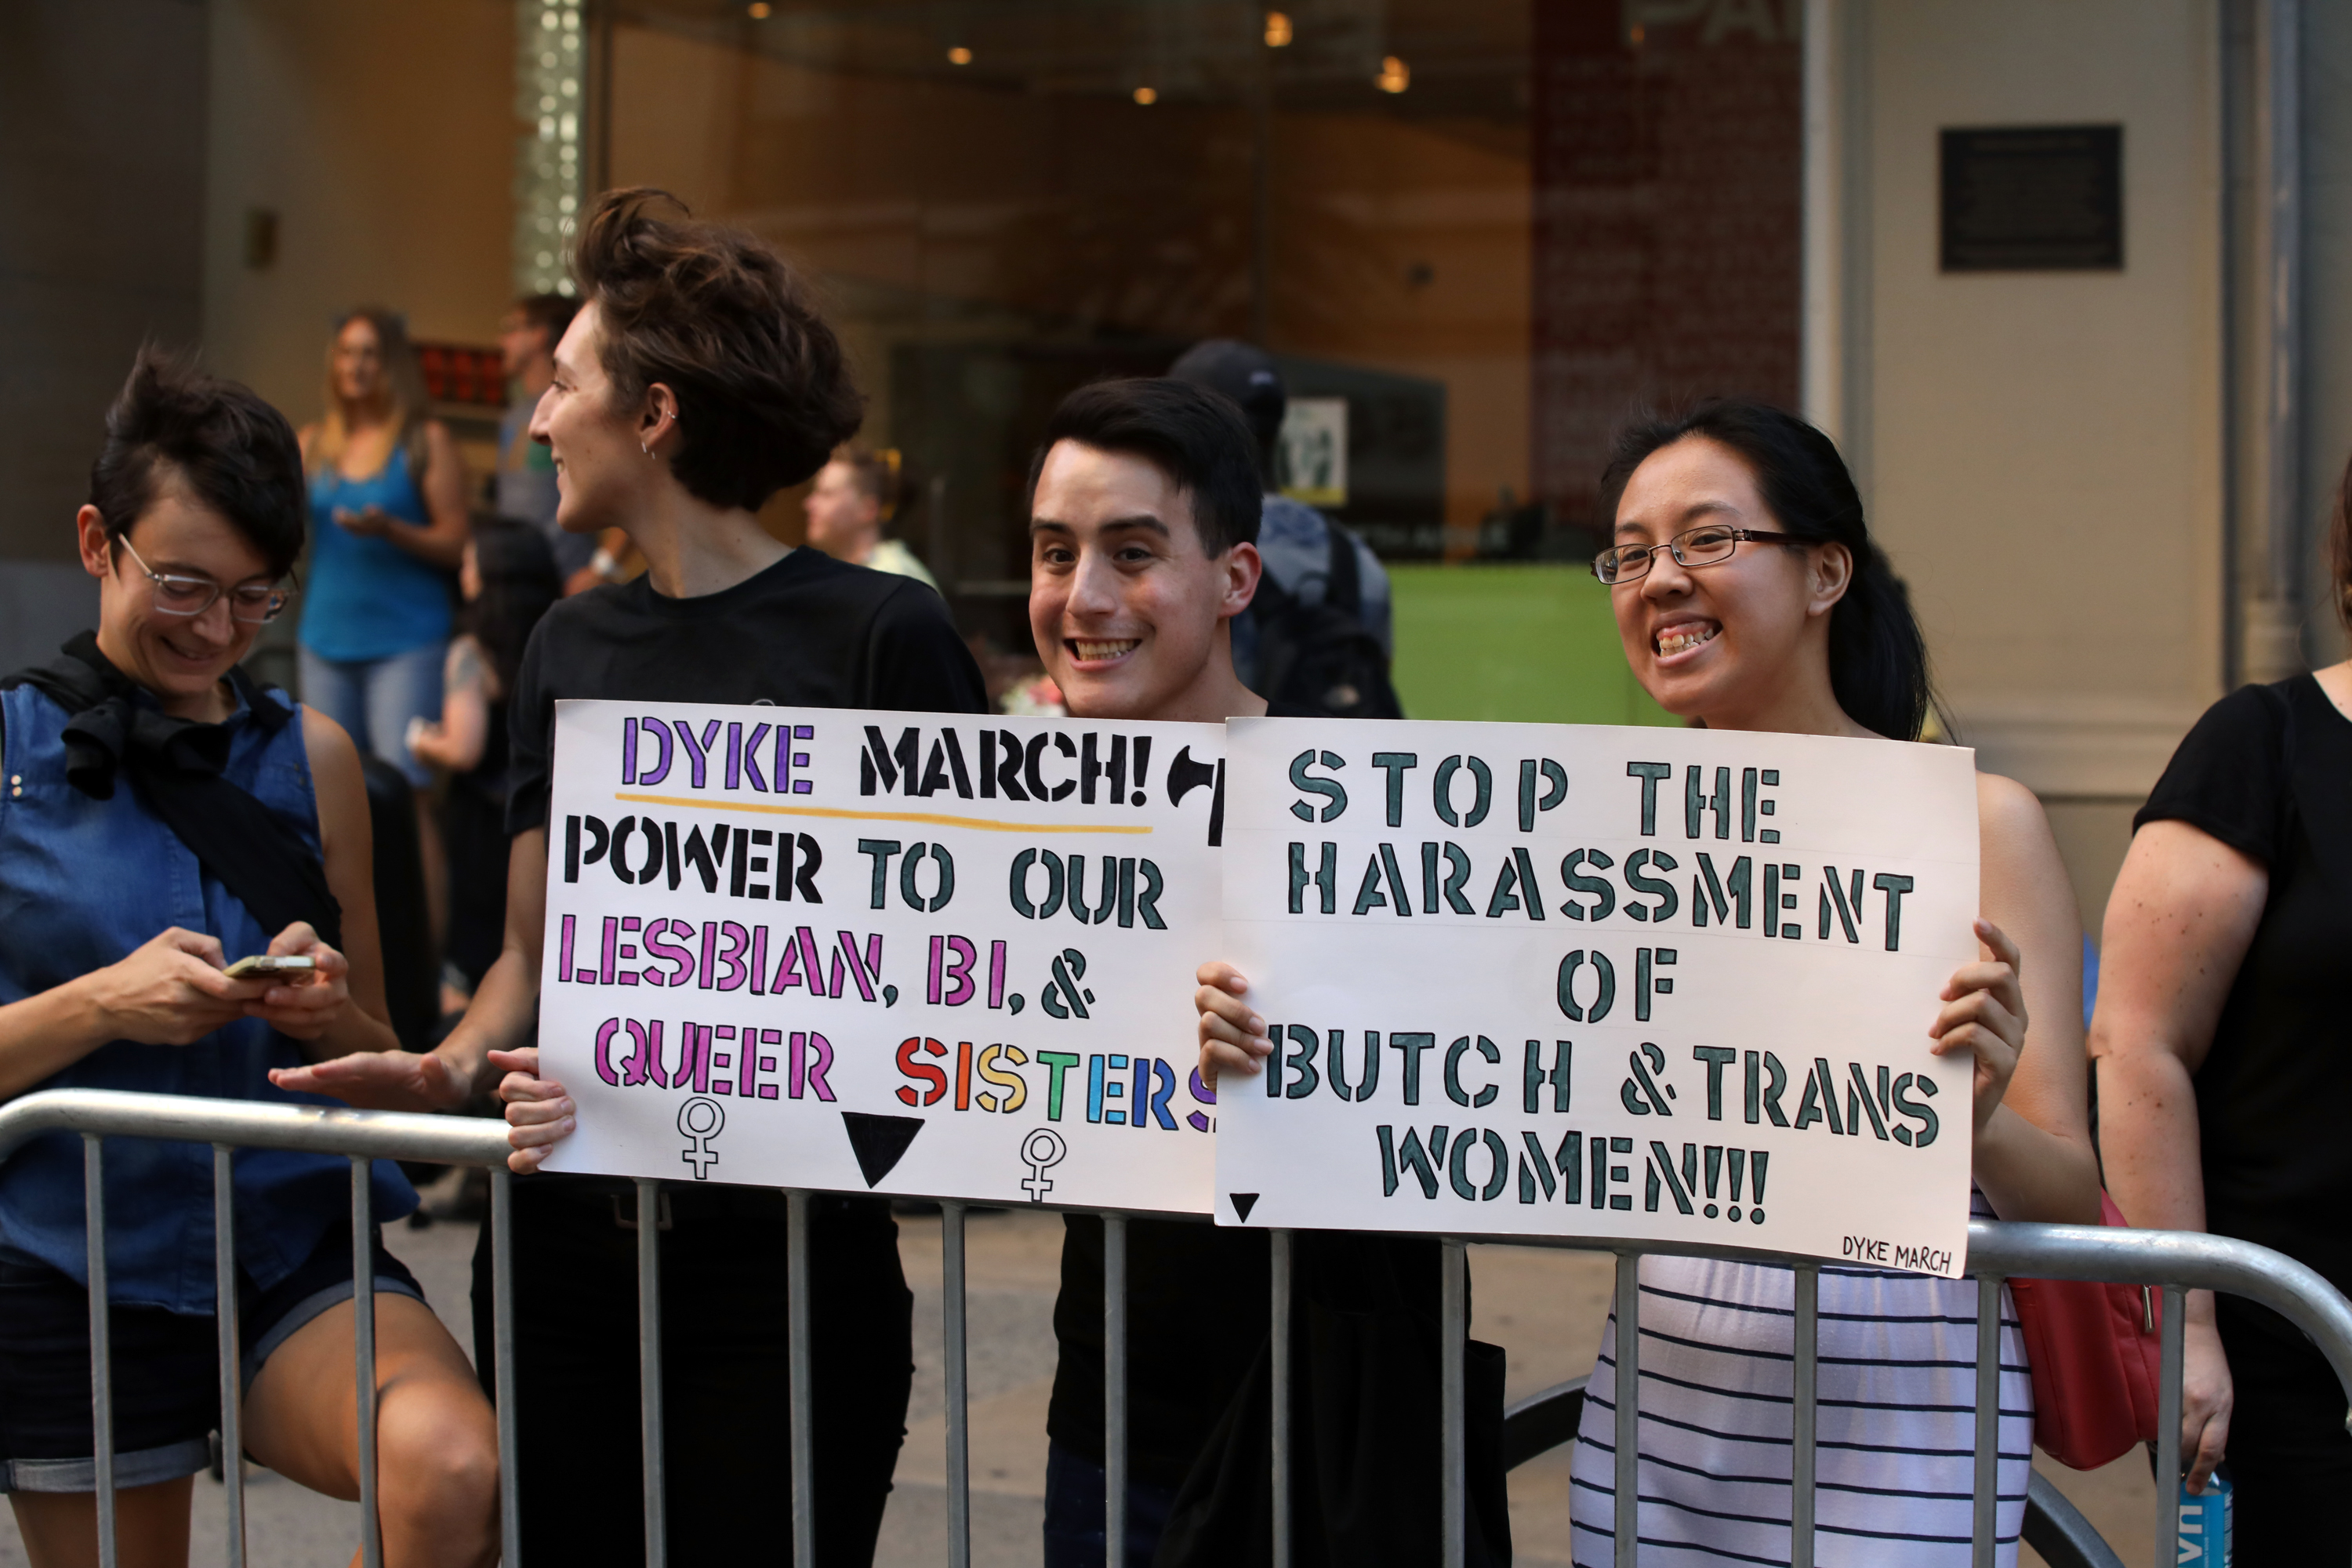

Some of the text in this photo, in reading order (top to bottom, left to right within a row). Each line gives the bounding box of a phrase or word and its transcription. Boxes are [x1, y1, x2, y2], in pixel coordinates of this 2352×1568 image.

[622, 717, 1152, 807] DYKE MARCH!
[1289, 749, 1780, 844] STOP THE
[564, 815, 1167, 930] POWER TO OUR
[1288, 841, 1913, 951] HARASSMENT
[558, 914, 1095, 1019] LESBIAN, BI, &
[1557, 947, 1677, 1023] OF
[595, 1018, 837, 1102] QUEER
[1266, 1024, 1939, 1148] BUTCH & TRANS
[1377, 1125, 1769, 1225] WOMEN!!!
[1843, 1236, 1951, 1274] DYKE MARCH
